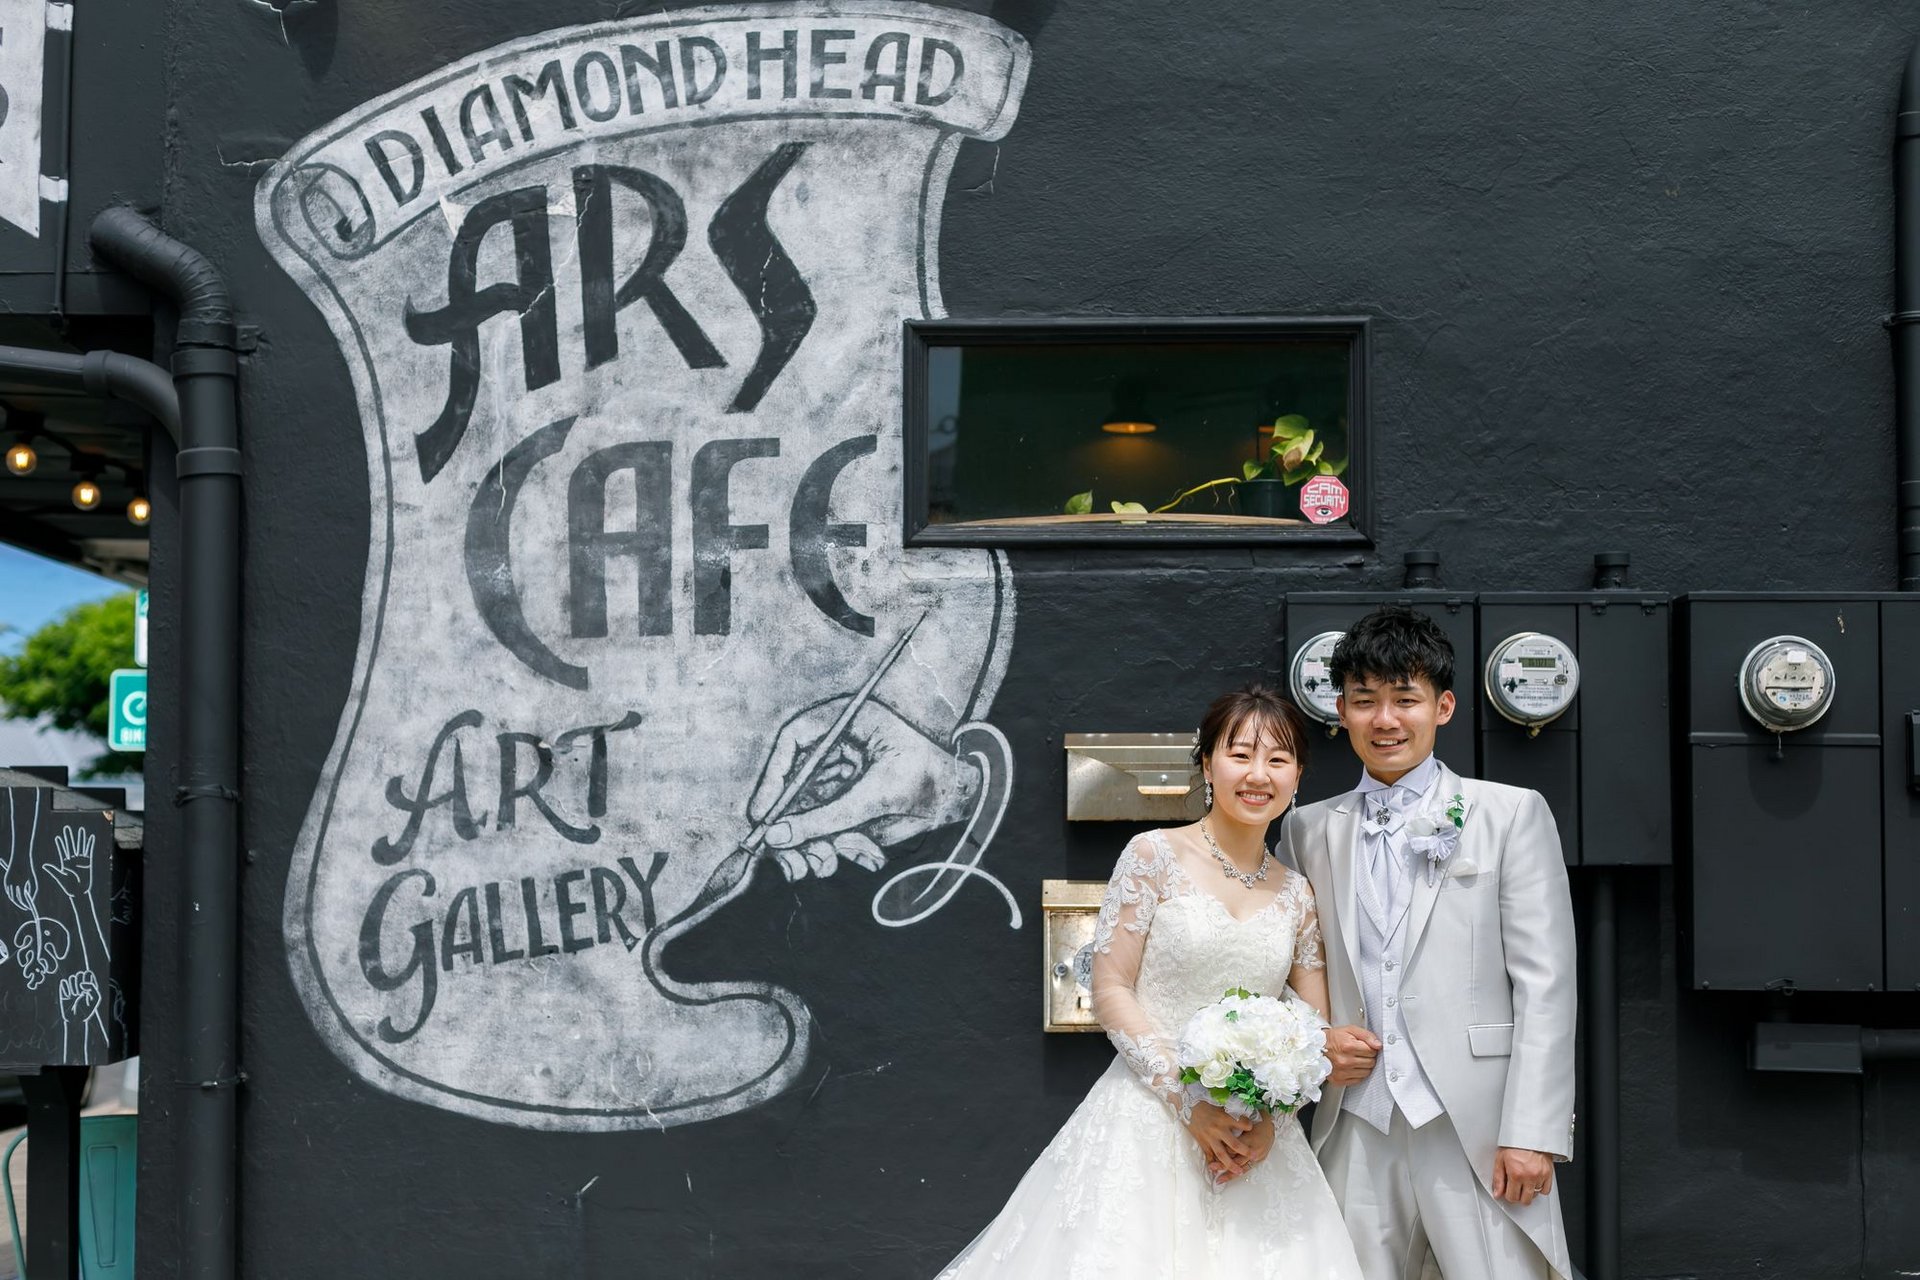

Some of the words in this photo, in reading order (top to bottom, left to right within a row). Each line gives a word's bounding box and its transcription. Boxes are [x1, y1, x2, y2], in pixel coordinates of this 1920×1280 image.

[364, 36, 728, 206] DIAMOND
[746, 29, 965, 106] HEAD
[405, 142, 817, 483] ARS
[464, 416, 877, 691] CAFE
[1303, 494, 1346, 510] SECURITY
[1307, 483, 1342, 495] CAM
[371, 710, 642, 865] ART
[358, 852, 670, 1044] GALLERY
